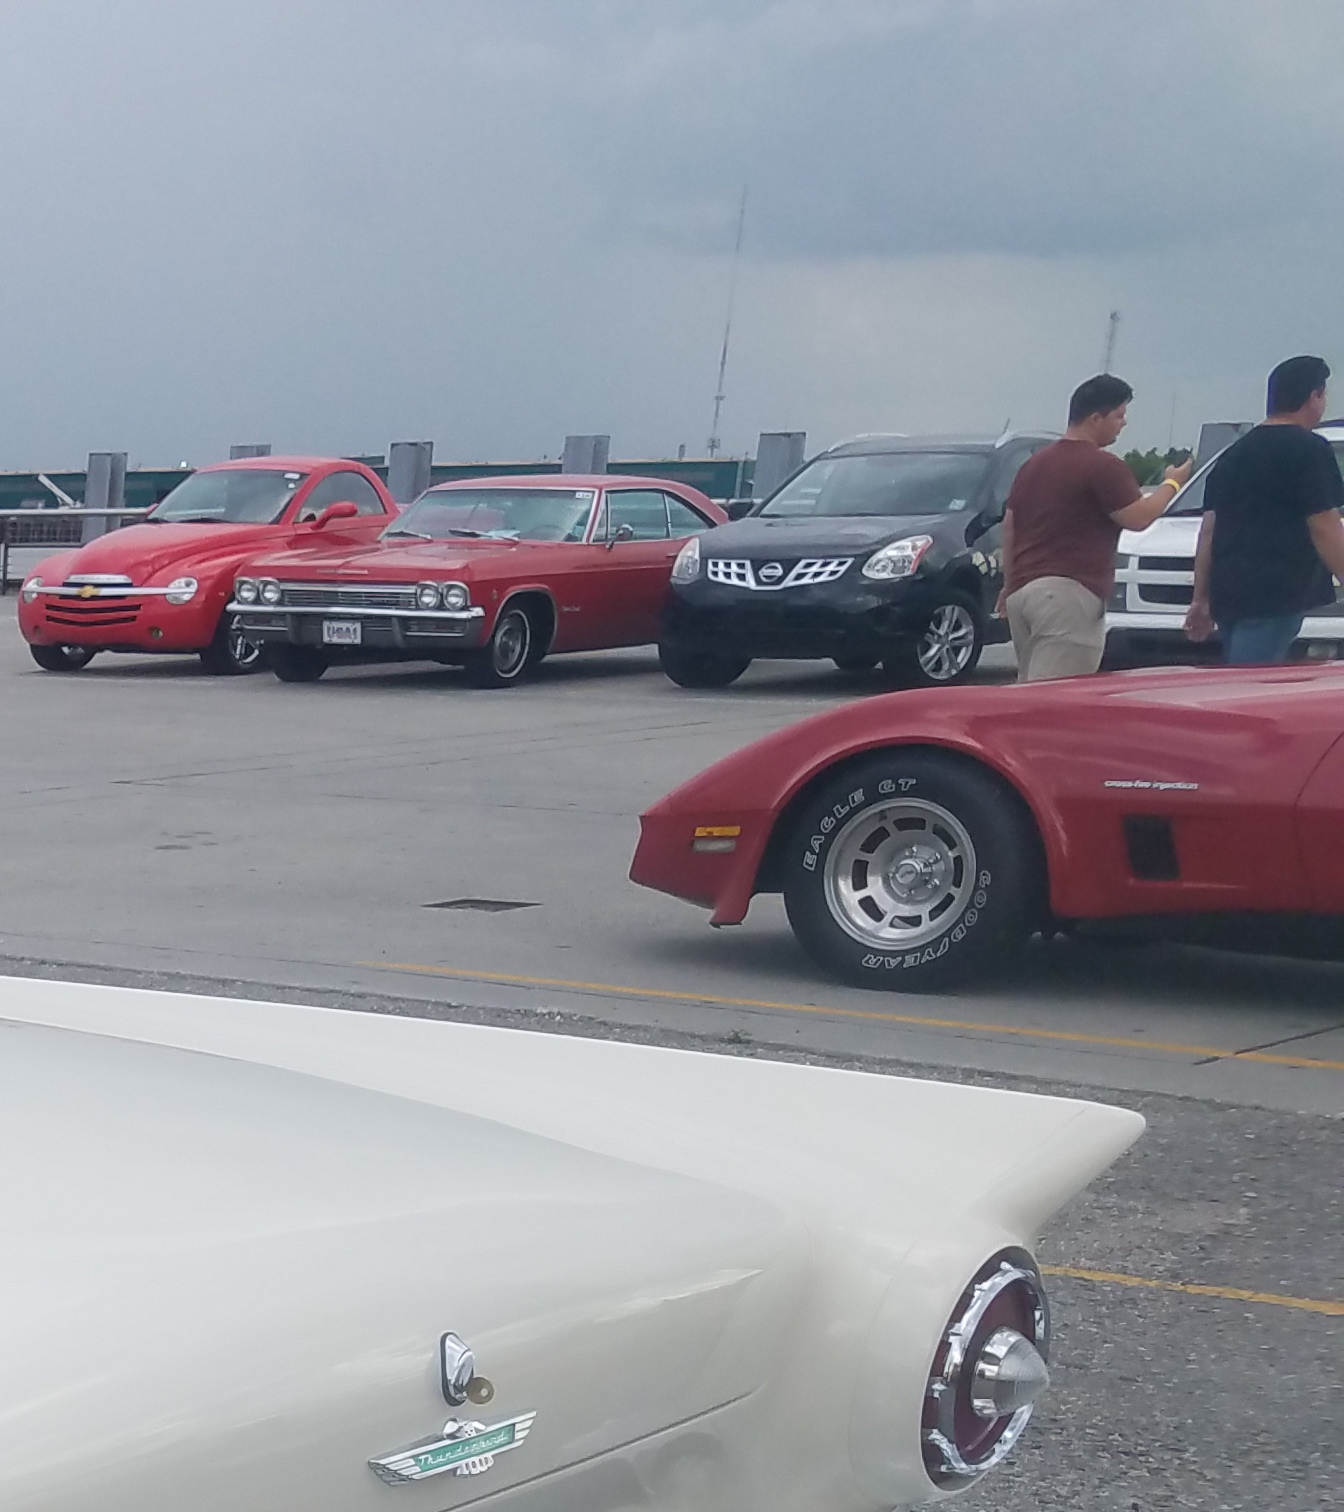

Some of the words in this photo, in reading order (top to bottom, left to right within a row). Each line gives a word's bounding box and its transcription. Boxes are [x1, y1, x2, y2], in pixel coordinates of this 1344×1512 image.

[802, 788, 865, 872] EAGLE
[878, 778, 916, 795] GT
[861, 870, 992, 969] GOODYEAR
[417, 1430, 508, 1466] Thunderbird
